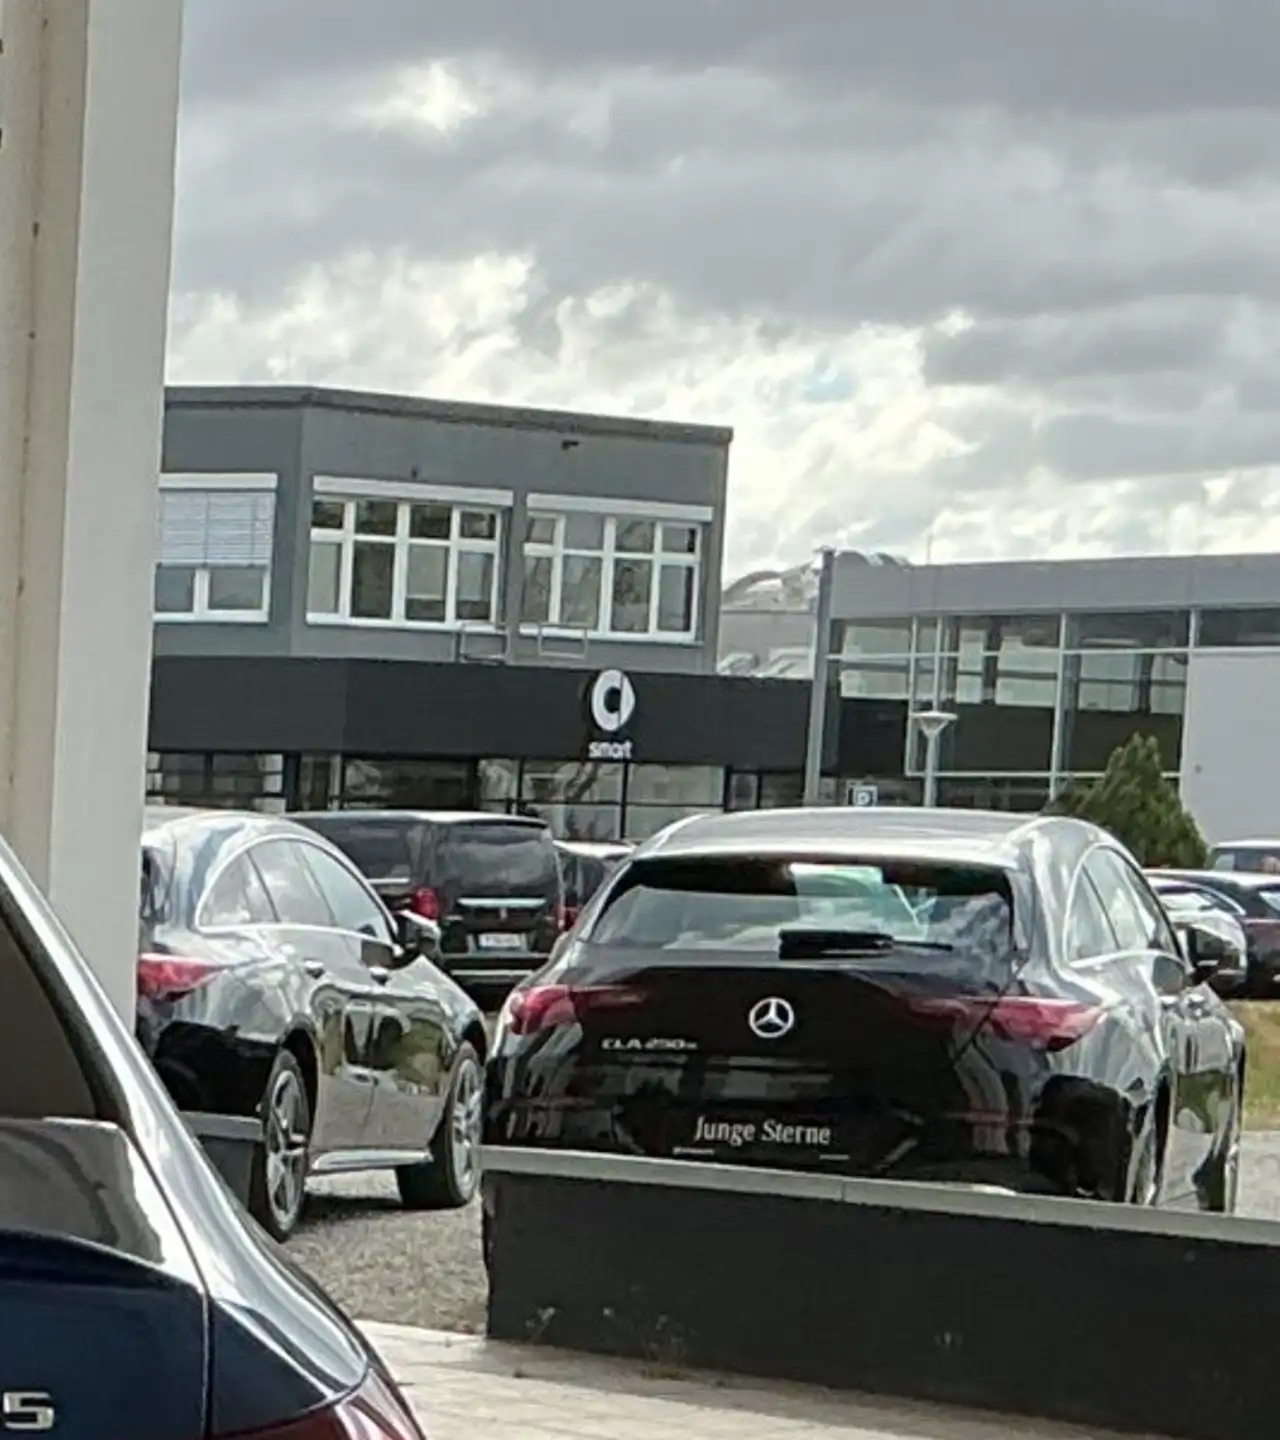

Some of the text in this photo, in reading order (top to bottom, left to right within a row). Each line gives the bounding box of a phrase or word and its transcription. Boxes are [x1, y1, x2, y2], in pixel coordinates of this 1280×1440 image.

[588, 740, 633, 759] smart
[693, 1115, 832, 1147] Junge Sterne
